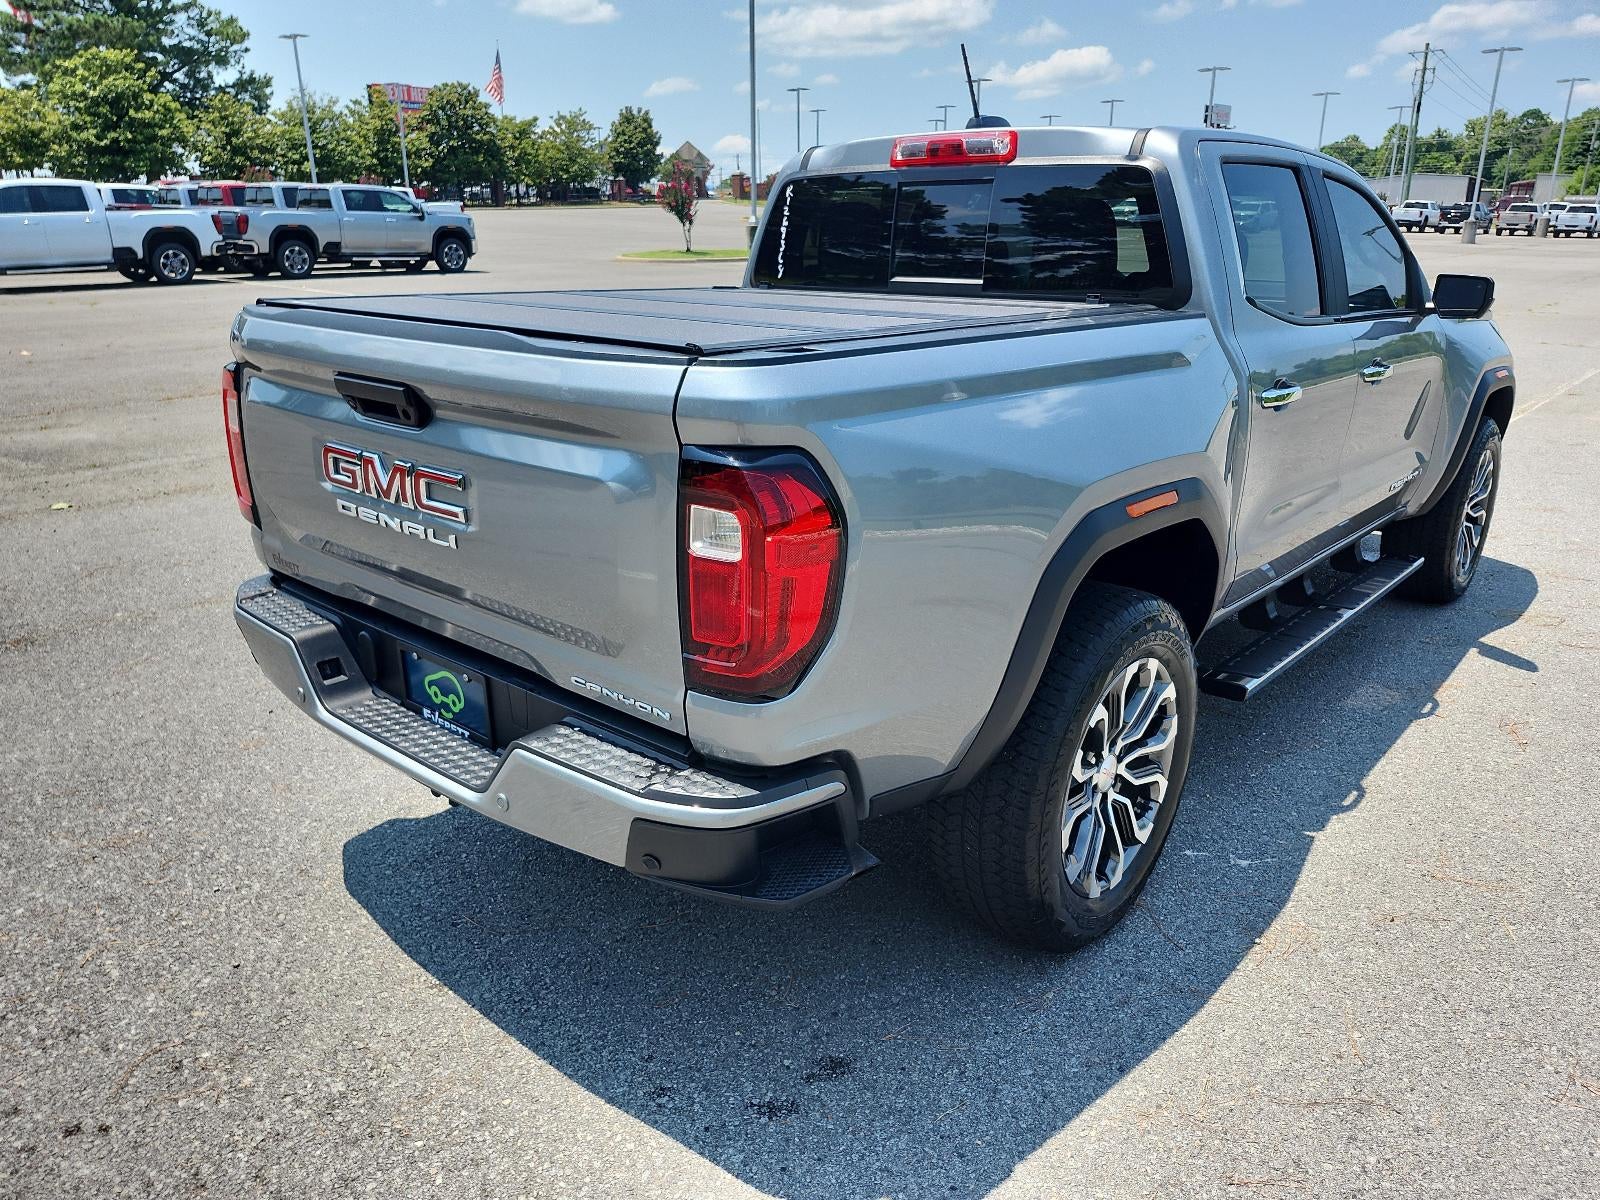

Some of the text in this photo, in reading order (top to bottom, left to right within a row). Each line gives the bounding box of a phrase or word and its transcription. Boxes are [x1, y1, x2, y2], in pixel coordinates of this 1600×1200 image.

[322, 441, 467, 524] GMC
[336, 498, 458, 550] DENALI
[570, 676, 672, 721] CANYON
